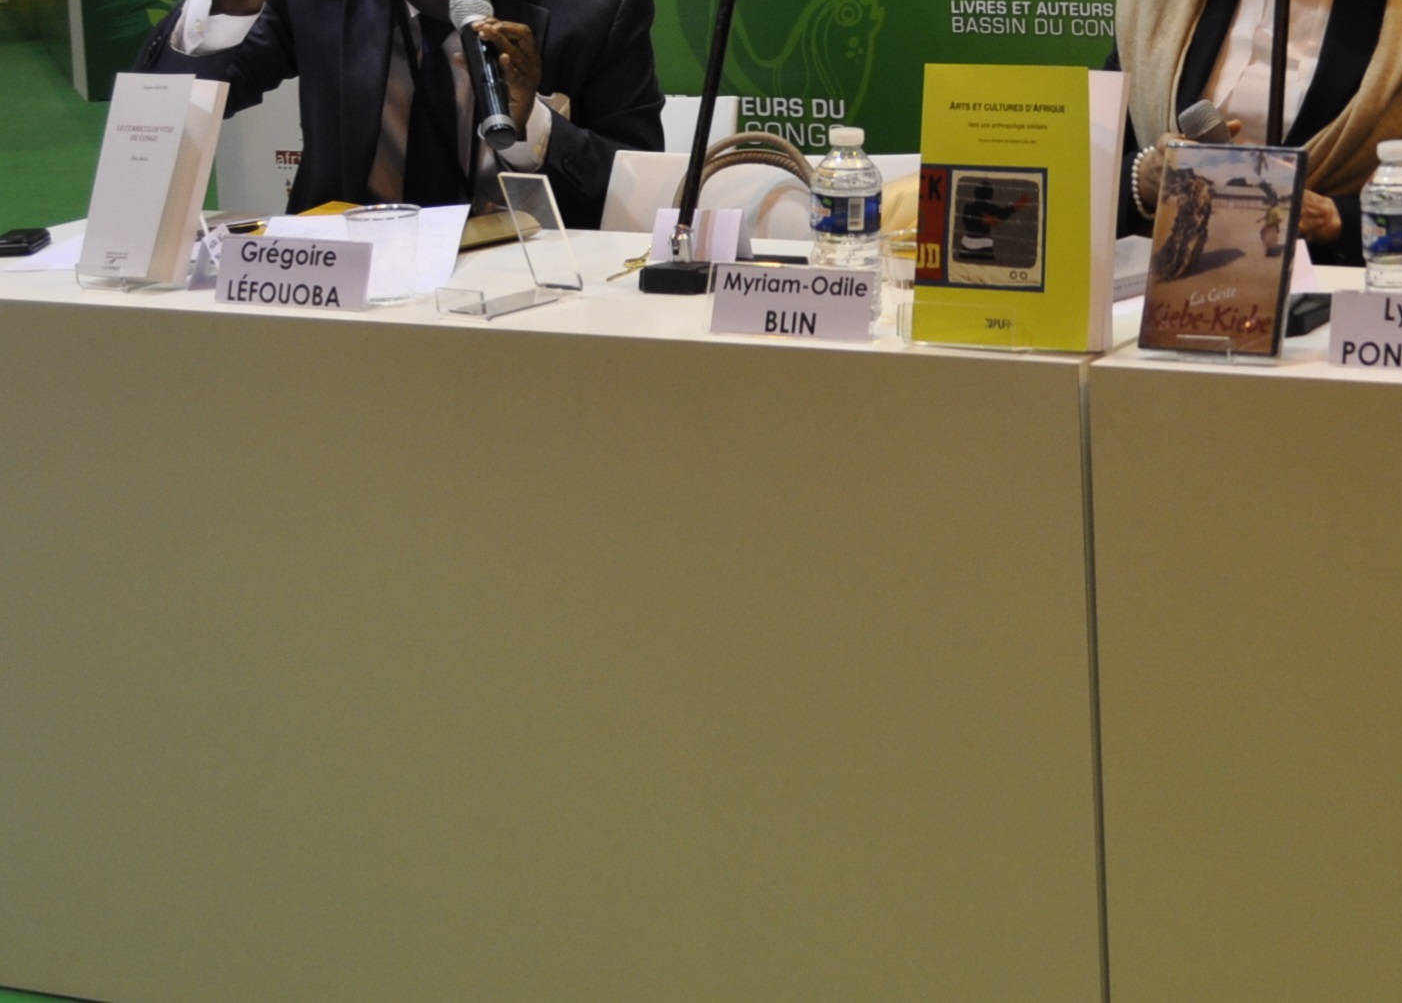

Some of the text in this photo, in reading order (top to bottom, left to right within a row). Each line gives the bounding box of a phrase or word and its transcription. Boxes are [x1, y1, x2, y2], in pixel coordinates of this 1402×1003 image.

[951, 0, 1114, 17] LIVRES ET AUTEURS
[952, 16, 1114, 37] BASSIN DU CON
[741, 97, 845, 120] EURS DU
[950, 101, 971, 111] ARTS
[972, 102, 982, 111] ET
[984, 103, 1024, 113] CULTURES
[744, 121, 845, 147] CONG
[241, 240, 337, 270] Grégoire
[227, 274, 340, 307] LÉFOUOBA
[723, 271, 868, 297] Myriam-Odile
[1208, 287, 1237, 304] Geste
[764, 310, 817, 335] BLIN
